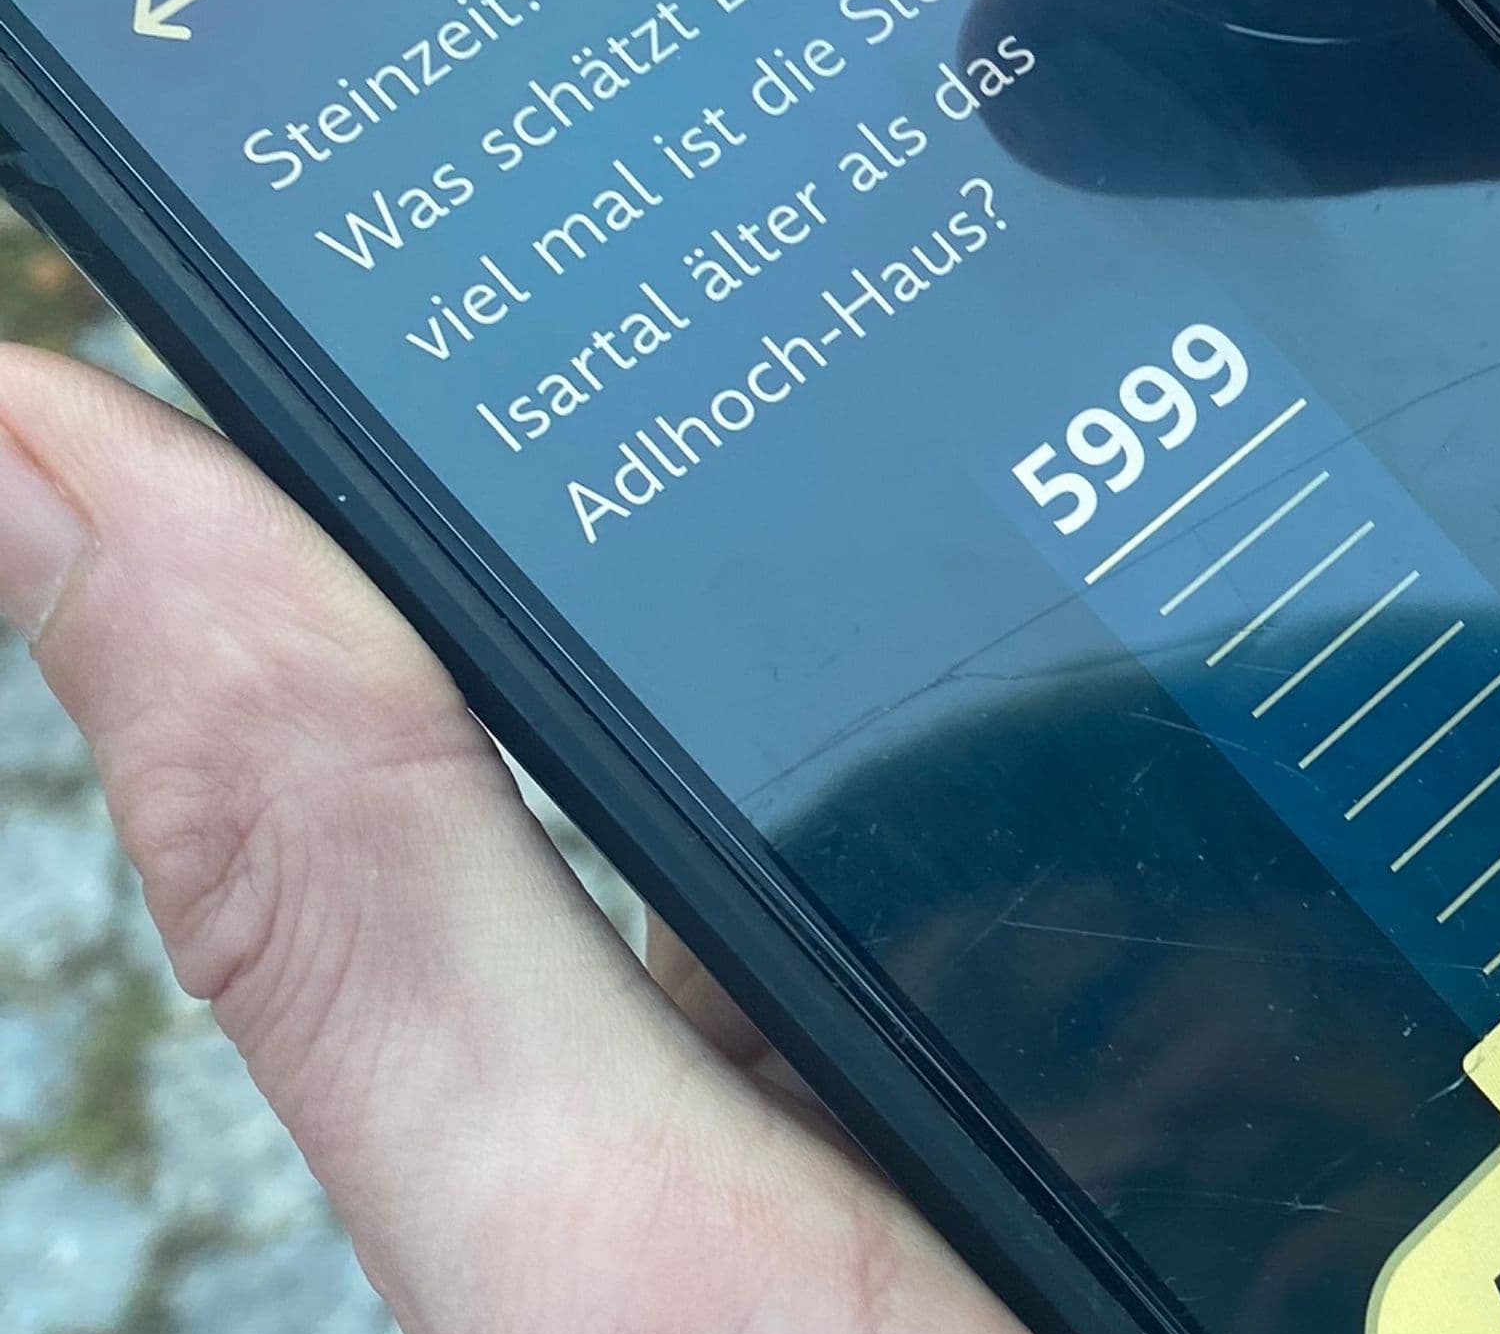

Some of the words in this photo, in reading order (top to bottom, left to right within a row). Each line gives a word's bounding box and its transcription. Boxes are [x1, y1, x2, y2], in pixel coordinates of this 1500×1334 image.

[315, 163, 475, 281] Was
[481, 1, 699, 171] schätzt
[406, 254, 531, 362] viel
[531, 159, 664, 275] mal
[653, 106, 748, 181] ist
[751, 37, 846, 116] die
[476, 283, 689, 453] Isartal
[685, 177, 828, 302] älter
[838, 115, 927, 193] als
[936, 35, 1036, 122] das
[566, 177, 1008, 543] Adlhoch-Haus?
[1011, 323, 1249, 536] 5999
